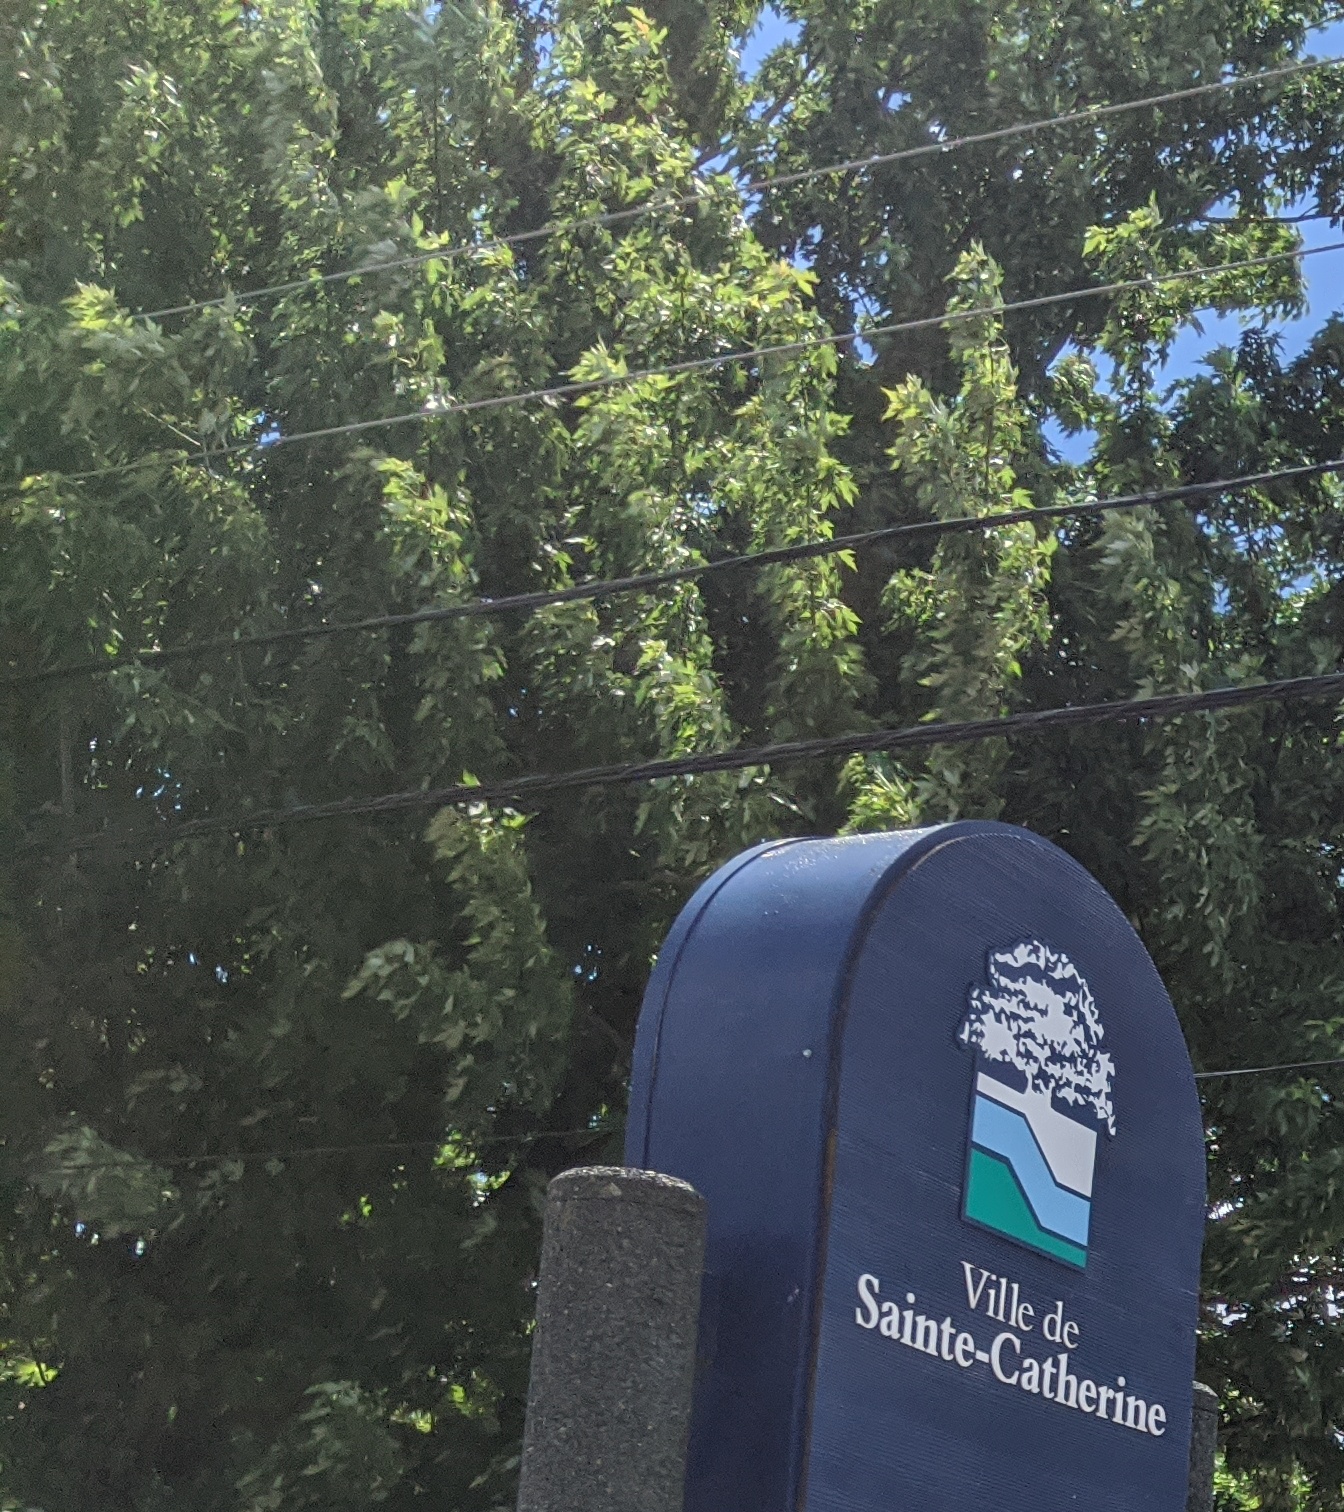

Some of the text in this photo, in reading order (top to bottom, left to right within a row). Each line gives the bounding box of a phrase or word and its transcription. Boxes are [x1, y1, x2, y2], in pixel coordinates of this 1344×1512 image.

[855, 1273, 1167, 1436] Sainte-Catherine
[960, 1260, 1080, 1349] Ville de
